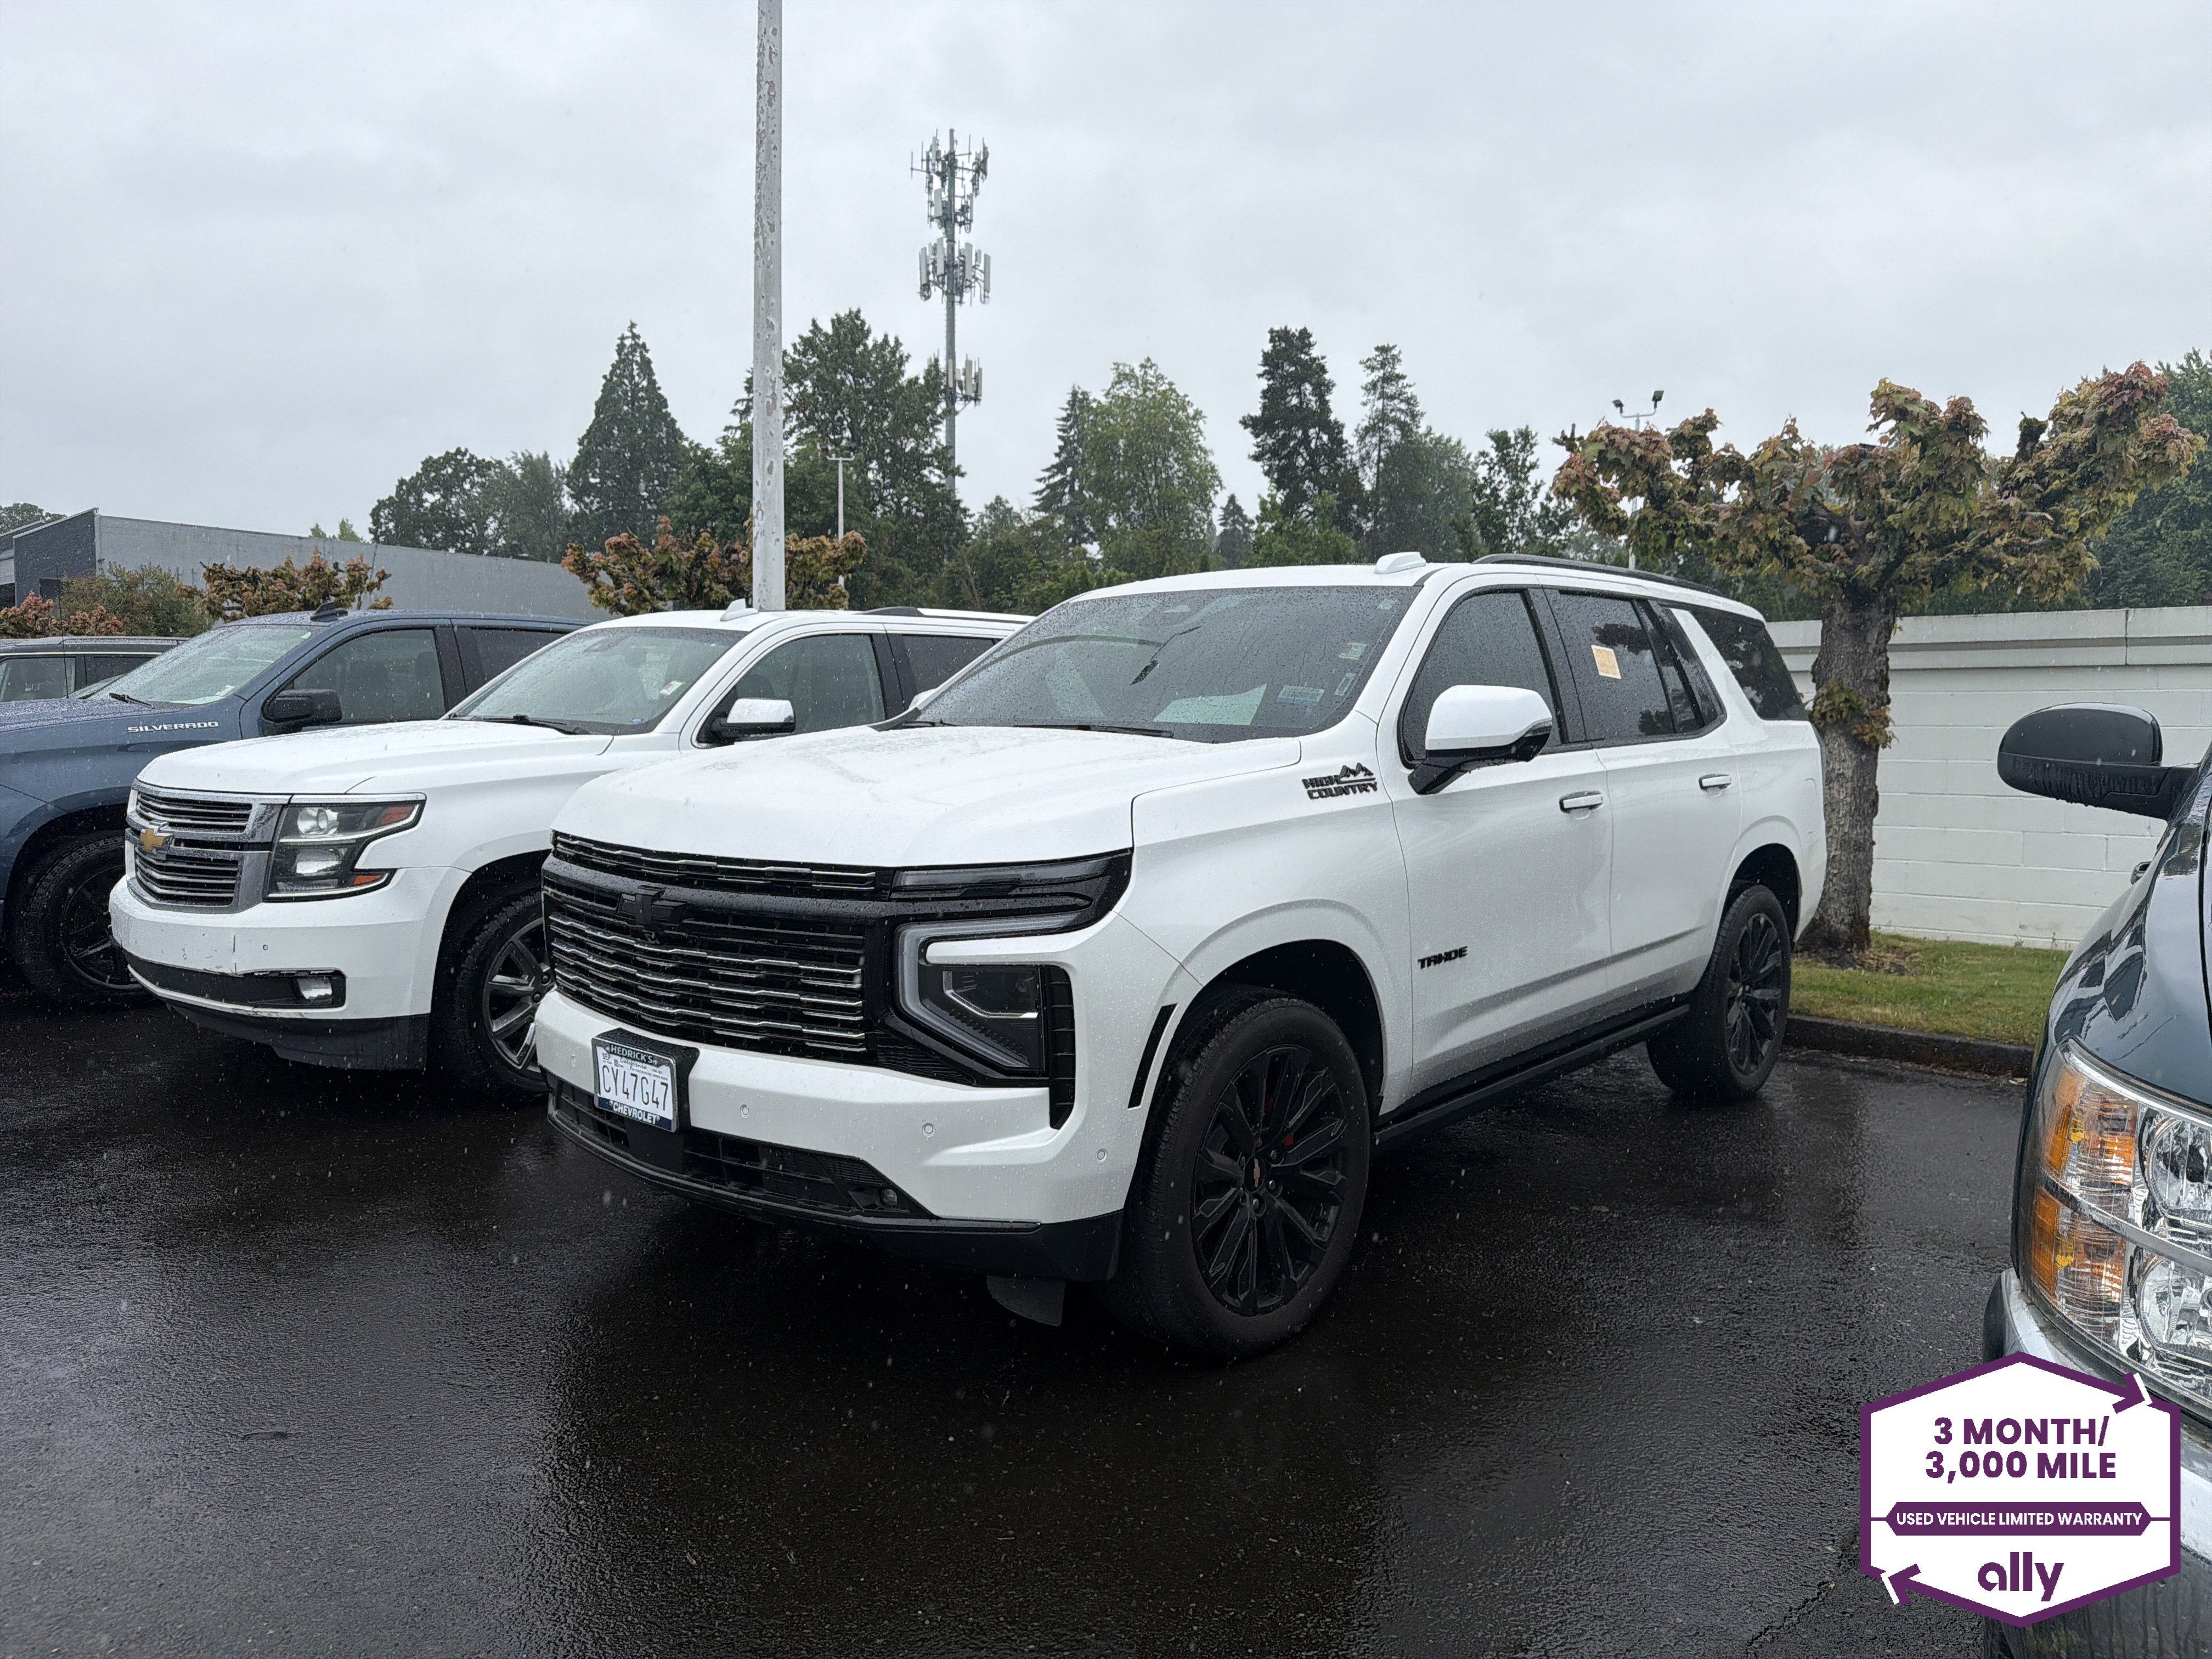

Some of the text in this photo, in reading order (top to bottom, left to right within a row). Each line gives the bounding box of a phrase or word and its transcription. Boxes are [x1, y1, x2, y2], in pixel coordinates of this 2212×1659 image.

[127, 721, 219, 733] SILVERADO
[1302, 774, 1341, 789] HIGH
[1307, 781, 1378, 799] COUNTRY
[1418, 945, 1468, 969] TAHOE
[611, 1045, 653, 1064] HEDRICK'S
[602, 1065, 669, 1111] CY47G47
[613, 1102, 659, 1125] CHEVROLET
